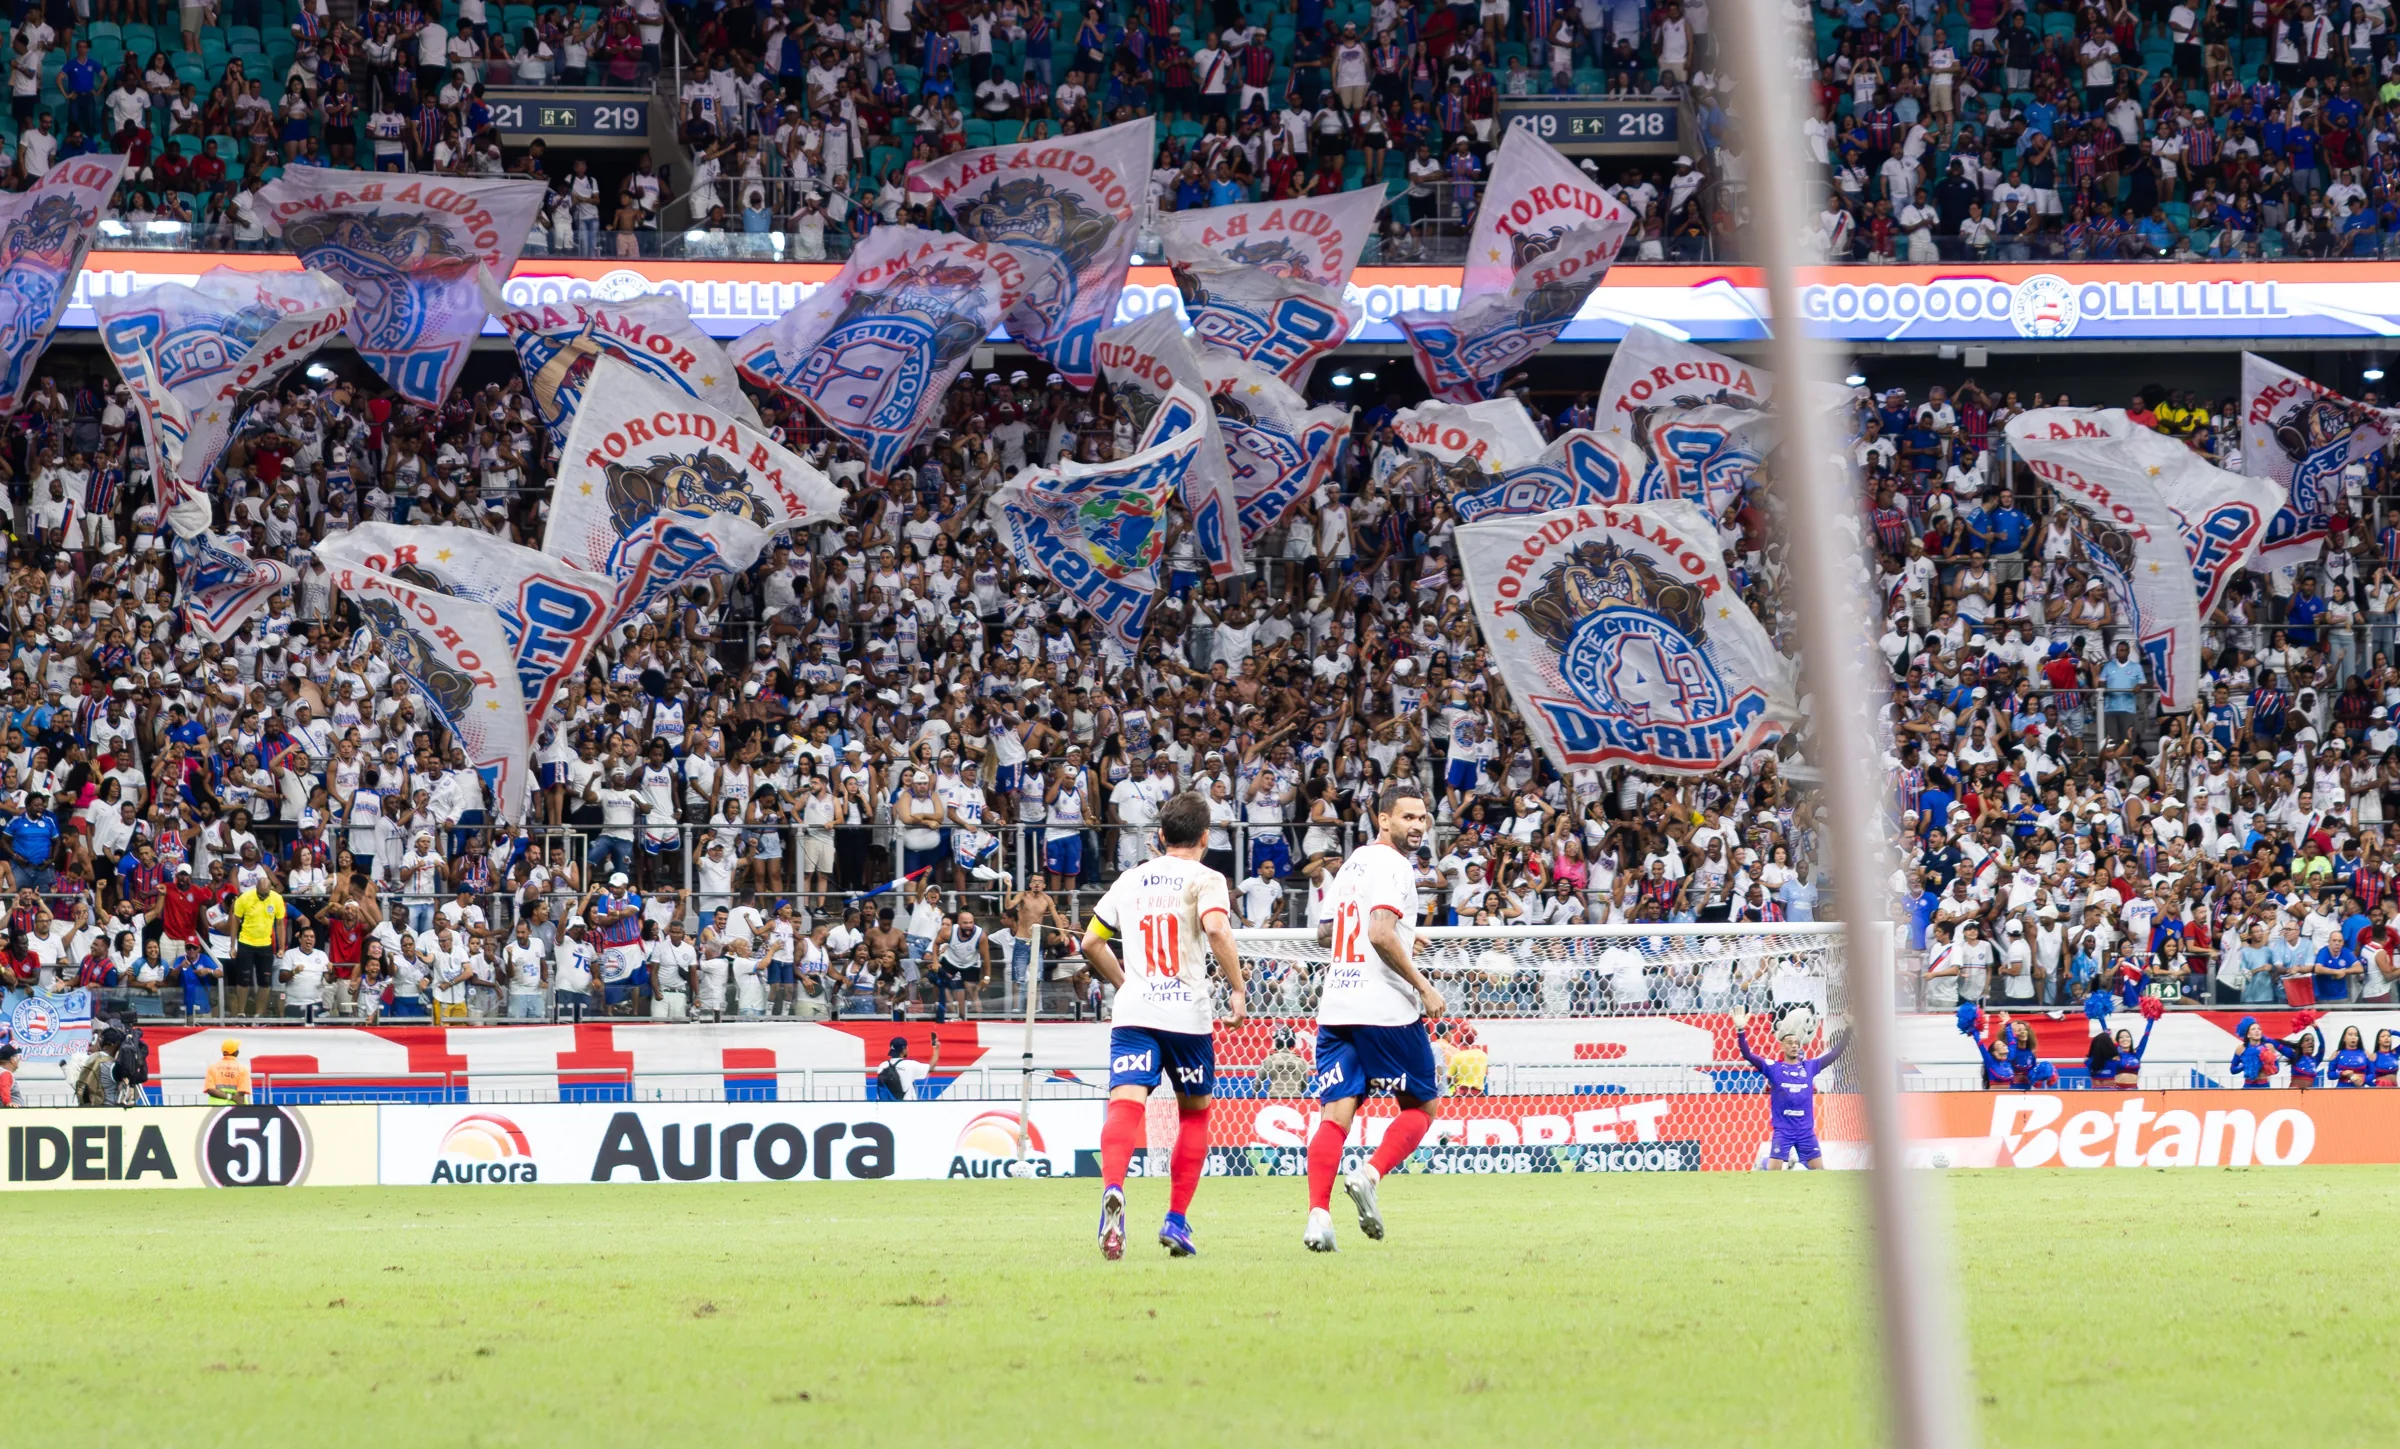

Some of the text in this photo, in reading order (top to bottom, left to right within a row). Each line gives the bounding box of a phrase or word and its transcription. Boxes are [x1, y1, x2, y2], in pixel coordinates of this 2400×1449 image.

[594, 107, 639, 129] 219
[1619, 113, 1664, 135] 218
[1495, 183, 1619, 236] TORCIDA
[217, 306, 348, 400] TORCIDA
[1616, 362, 1758, 415] TORCIDA
[586, 411, 741, 469] TORCIDA
[1494, 509, 1721, 617] TORCIDA BAMOR
[1151, 873, 1183, 891] bmg
[1139, 912, 1180, 978] 10
[1333, 900, 1365, 963] 12
[1150, 979, 1181, 992] VIVA
[1334, 968, 1361, 978] VIVA
[1112, 1049, 1152, 1073] axi
[8, 1117, 281, 1183] IDEIA 51
[591, 1112, 895, 1182] Aurora
[1990, 1094, 2316, 1168] Betano
[431, 1158, 537, 1184] Aurora
[1432, 1153, 1533, 1174] SICOOB
[1584, 1149, 1683, 1173] SICOOB
